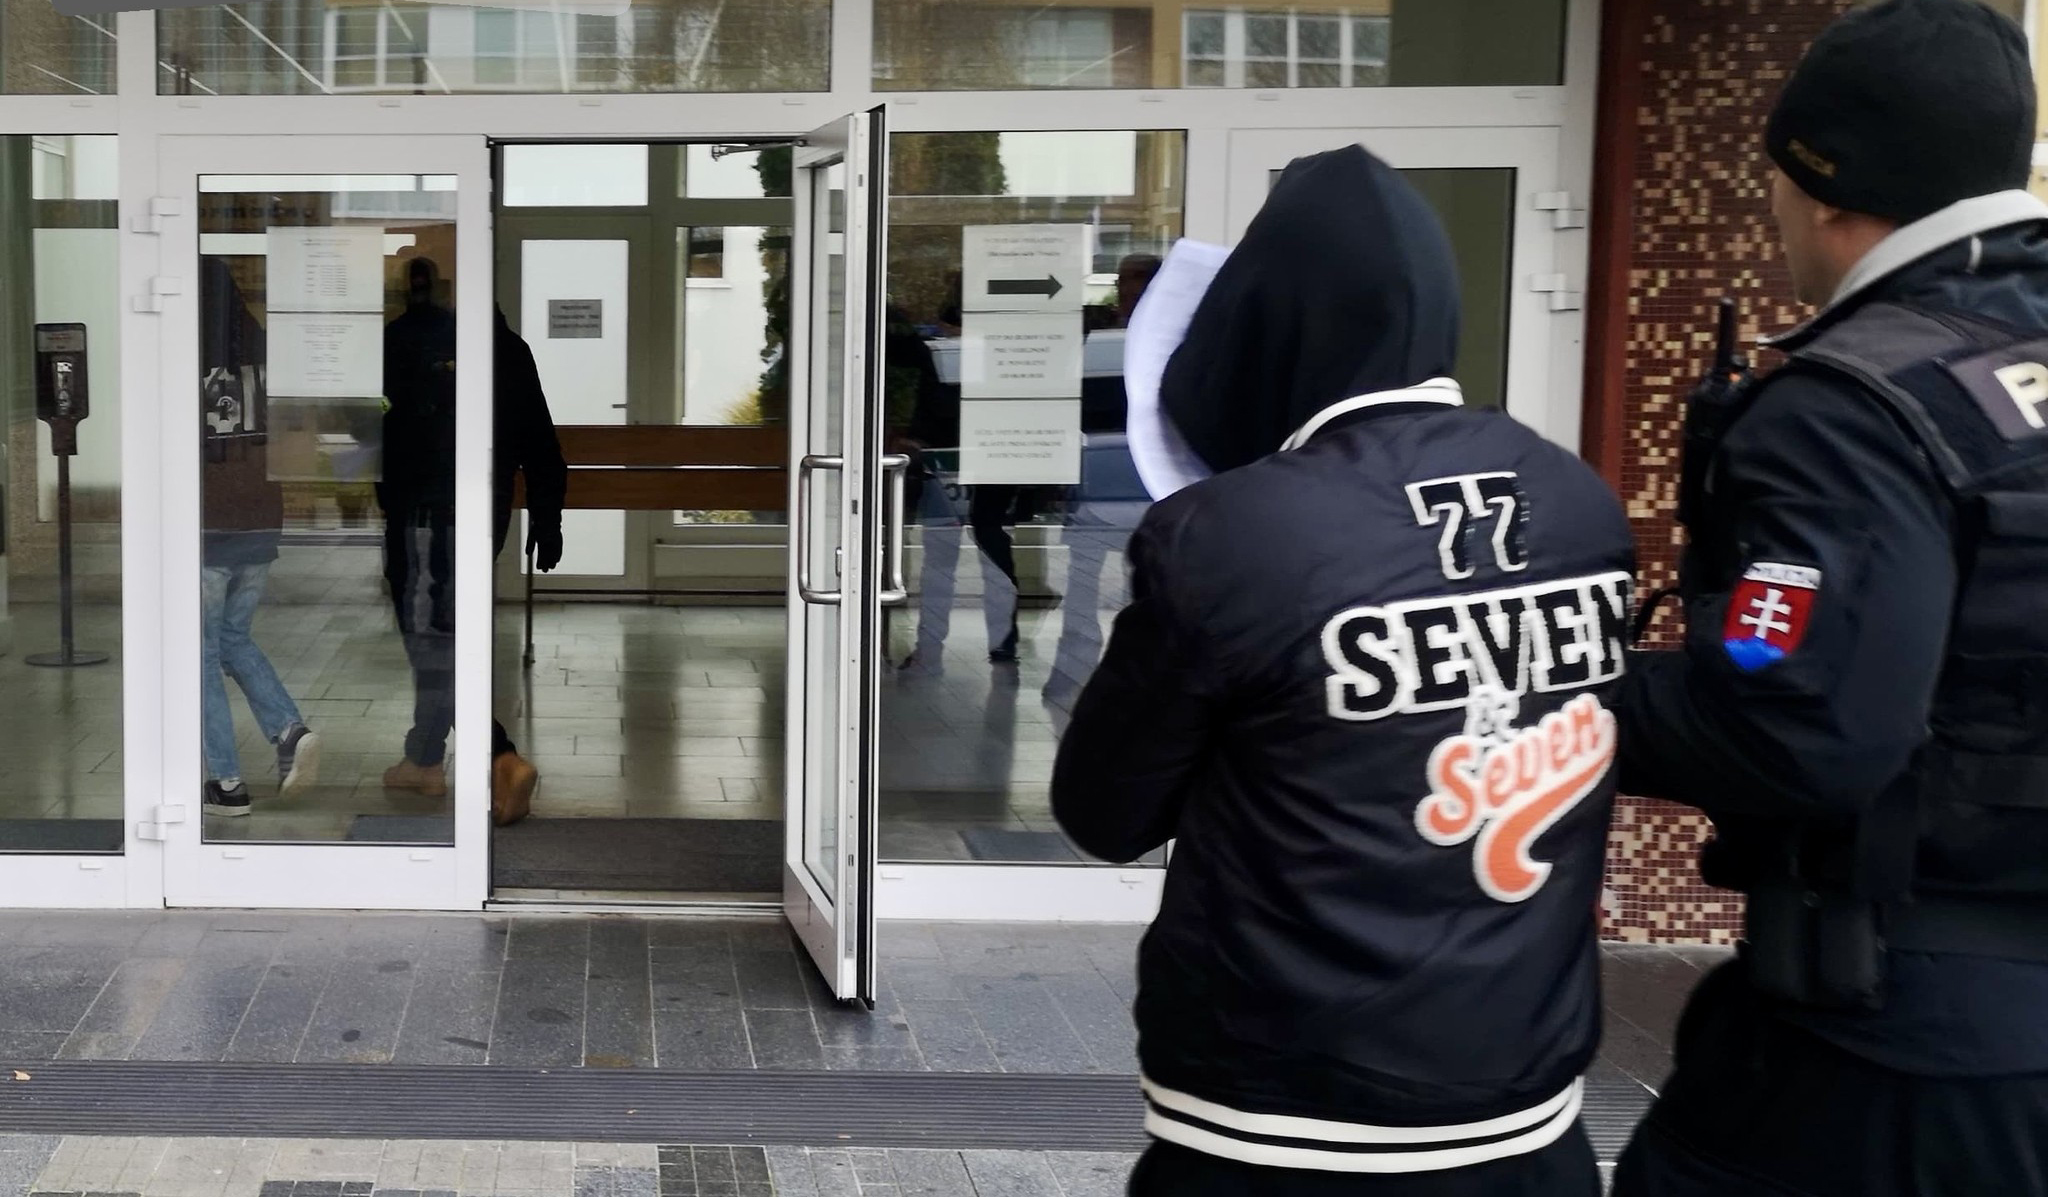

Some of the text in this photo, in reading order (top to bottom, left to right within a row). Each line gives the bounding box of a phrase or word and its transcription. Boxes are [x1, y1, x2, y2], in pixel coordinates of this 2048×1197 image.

[1404, 471, 1530, 580] 77
[1321, 571, 1634, 721] SEVEN
[1414, 693, 1617, 903] Seven
